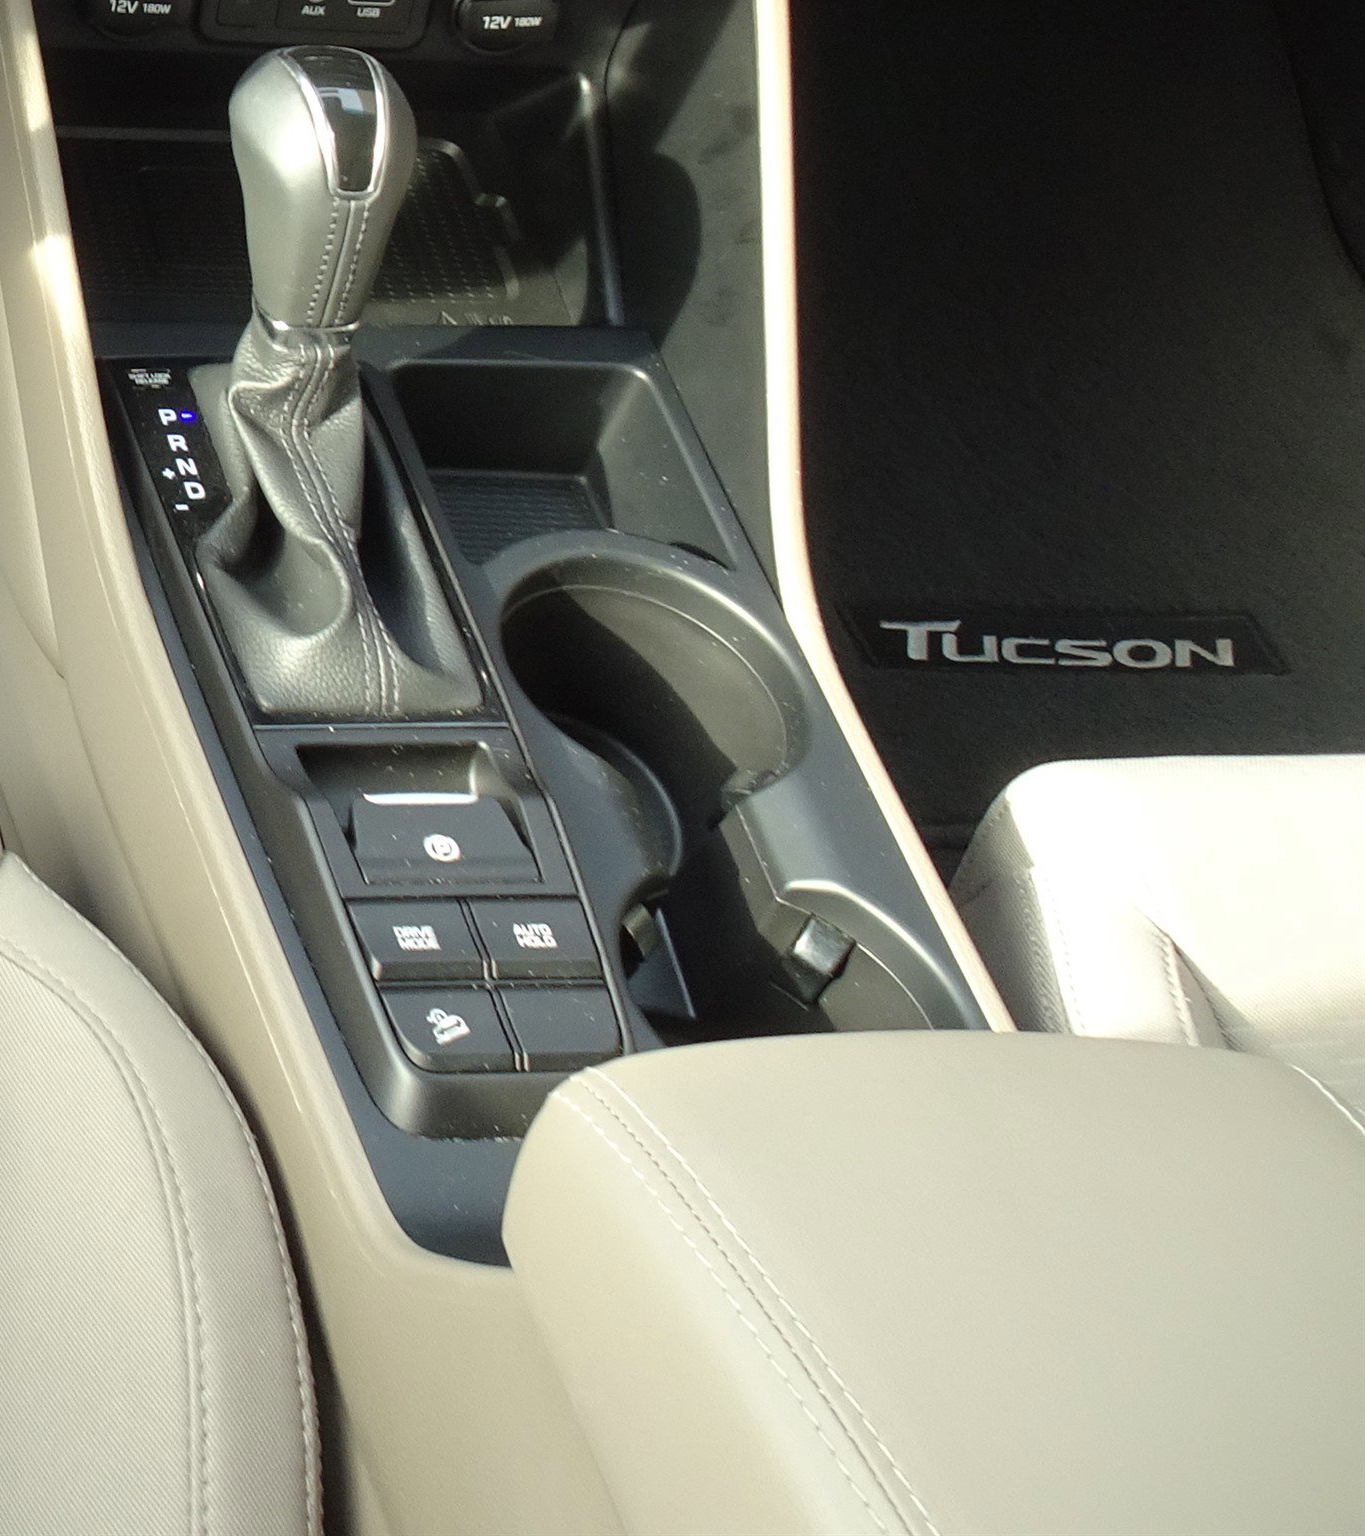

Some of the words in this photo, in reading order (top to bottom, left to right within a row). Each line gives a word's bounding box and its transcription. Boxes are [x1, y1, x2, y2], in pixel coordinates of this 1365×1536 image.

[143, 2, 171, 15] 180W
[301, 5, 325, 16] AUX
[357, 7, 381, 18] USB
[482, 15, 512, 30] 12V
[158, 408, 177, 426] P
[167, 434, 188, 452] R
[176, 457, 198, 476] N
[183, 481, 206, 500] D
[392, 925, 435, 938] DRIVE
[513, 923, 554, 936] AUTO
[398, 937, 441, 951] MODE
[516, 935, 558, 948] HOLD
